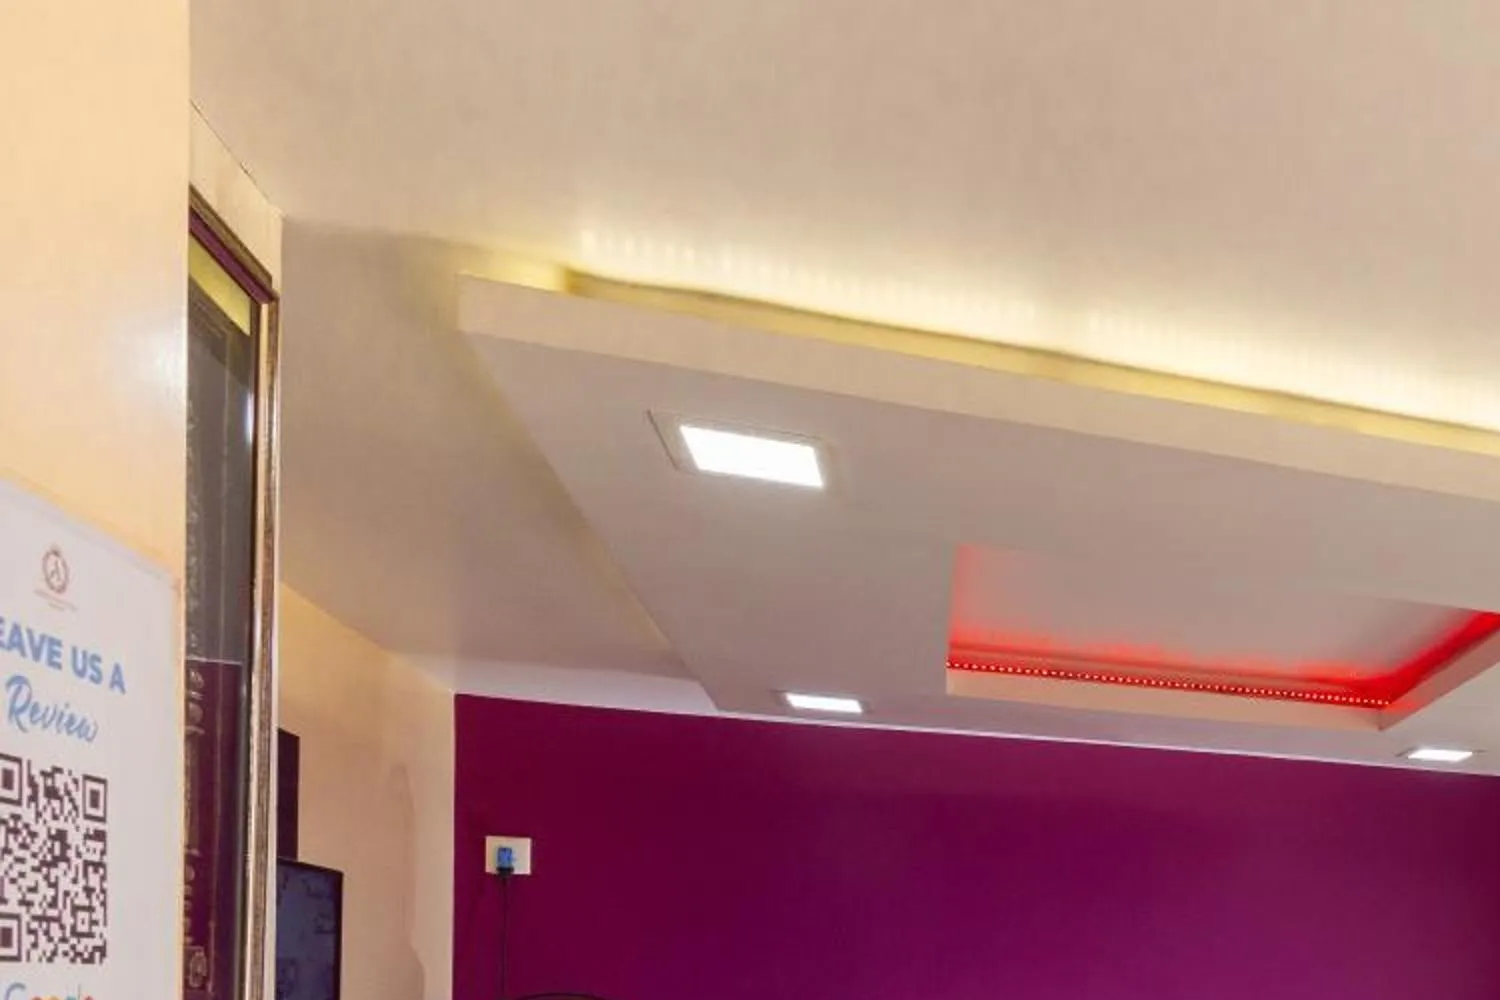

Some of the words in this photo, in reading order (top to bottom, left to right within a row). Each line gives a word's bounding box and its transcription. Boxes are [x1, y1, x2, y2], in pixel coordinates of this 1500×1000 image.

[71, 645, 103, 685] US
[109, 662, 126, 695] A
[5, 675, 99, 742] Review
